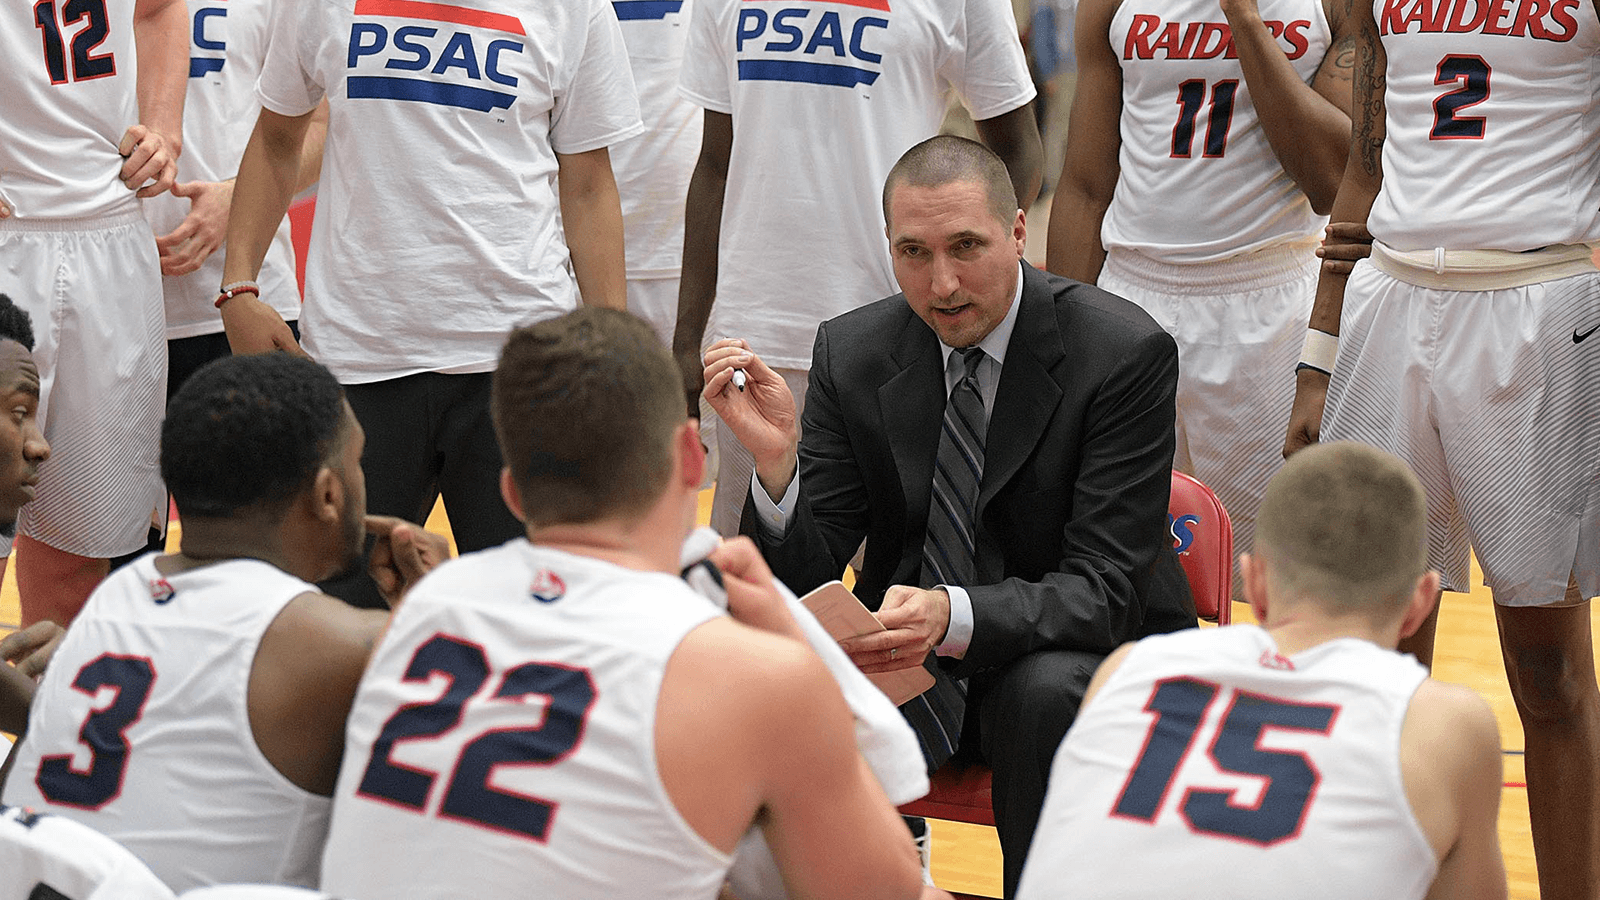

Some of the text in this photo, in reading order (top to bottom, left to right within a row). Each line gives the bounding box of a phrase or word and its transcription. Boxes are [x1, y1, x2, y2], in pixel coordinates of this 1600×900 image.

[33, 0, 117, 85] 12
[347, 23, 524, 88] PSAC
[737, 8, 889, 64] PSAC
[1381, 0, 1580, 42] RAIDERS
[1169, 79, 1239, 158] 11
[1429, 54, 1492, 140] 2
[35, 652, 158, 812] 3
[357, 632, 600, 845] 22
[1109, 675, 1342, 849] 15
